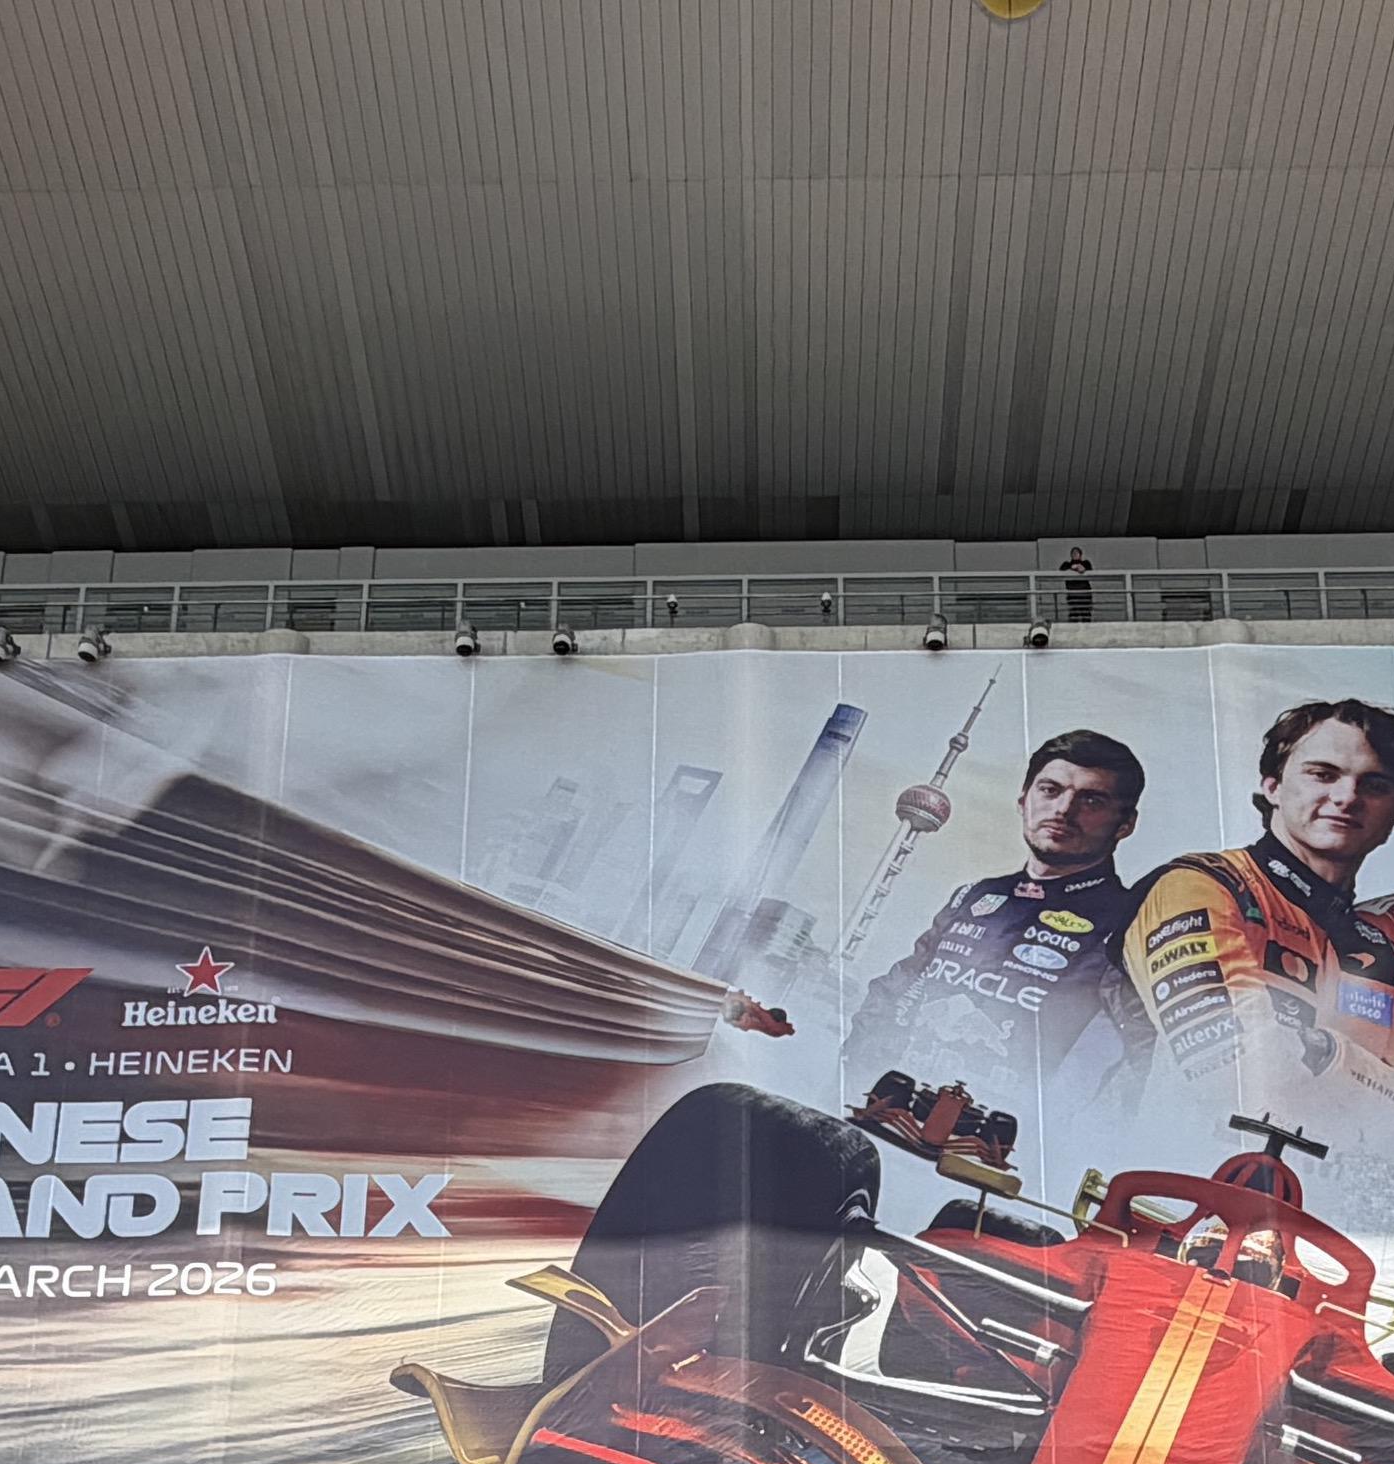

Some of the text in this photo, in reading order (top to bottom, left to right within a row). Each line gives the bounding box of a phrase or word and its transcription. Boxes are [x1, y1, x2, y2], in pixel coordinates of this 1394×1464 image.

[925, 957, 1048, 1012] ORACLE
[122, 998, 278, 1027] Heineken
[30, 1053, 52, 1077] 1
[89, 1048, 293, 1075] HEINEKEN
[196, 1172, 454, 1238] PRIX
[148, 1262, 277, 1297] 2026
